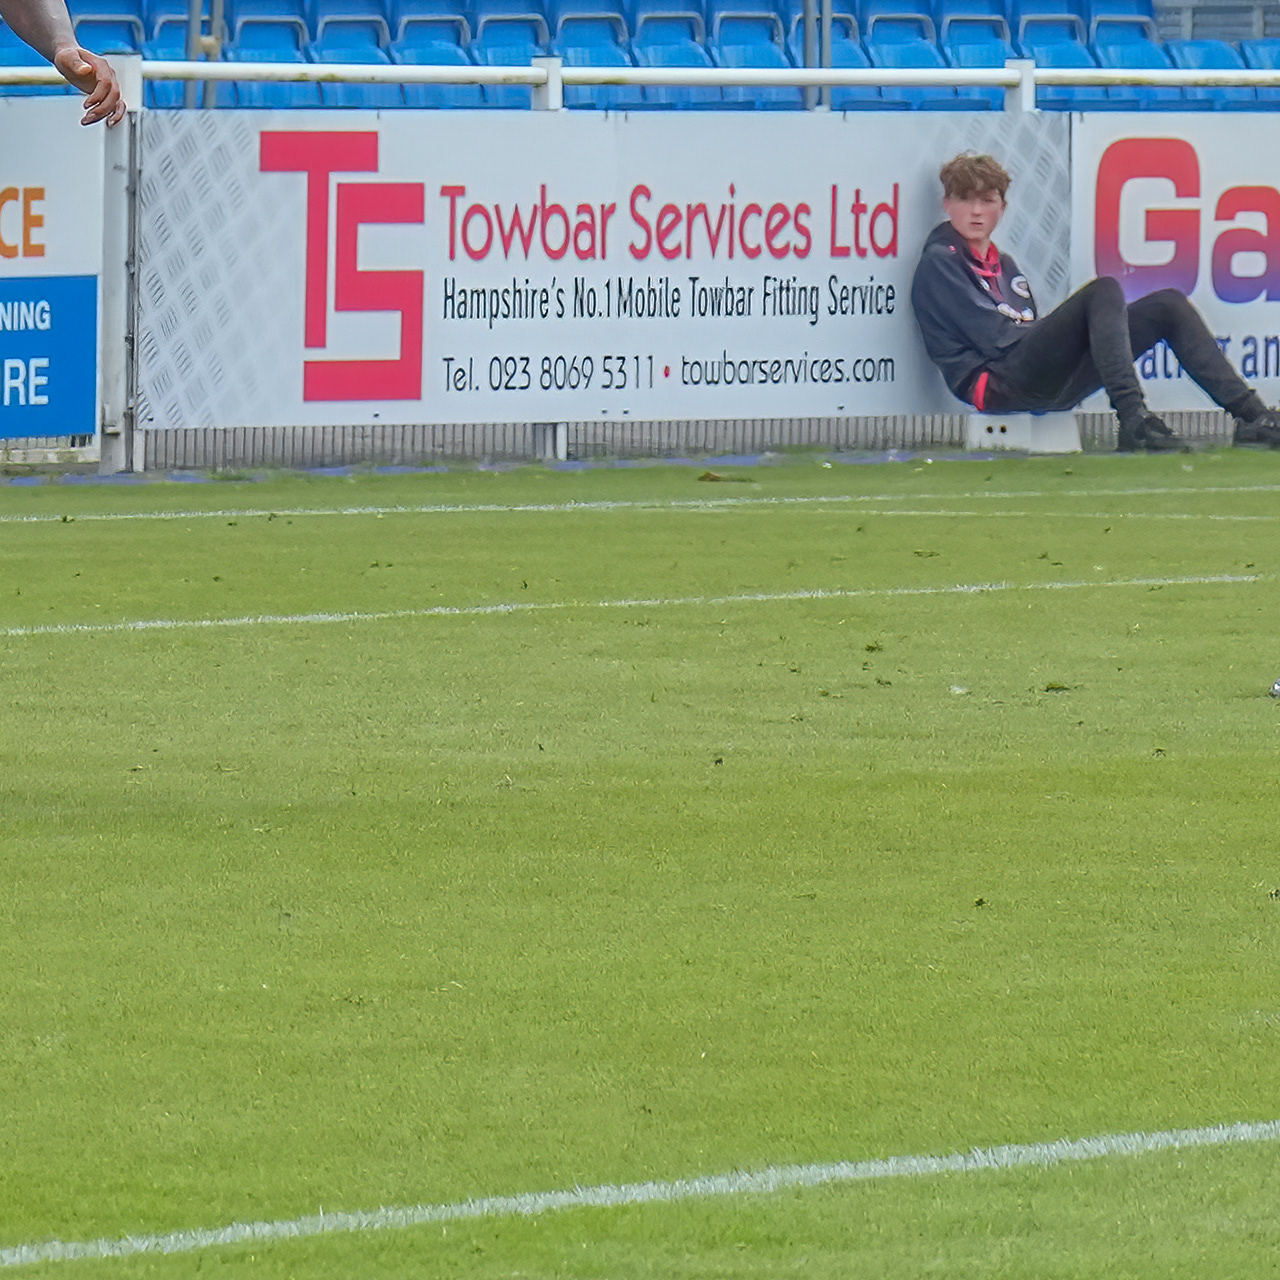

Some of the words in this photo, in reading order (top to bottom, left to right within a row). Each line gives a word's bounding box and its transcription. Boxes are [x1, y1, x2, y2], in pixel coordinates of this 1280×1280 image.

[440, 183, 617, 261] Towbar
[629, 183, 812, 260] Services
[830, 183, 900, 258] Ltd
[443, 276, 565, 330] Hampshire's
[618, 276, 681, 318] Mobile
[688, 275, 755, 318] Towbar
[762, 275, 820, 326] Fitting
[827, 274, 896, 316] Service
[442, 356, 480, 391] Tel.
[489, 355, 531, 391] 023
[539, 355, 594, 390] 8069
[601, 355, 654, 389] 5311
[681, 349, 896, 385] towbarservices.com
